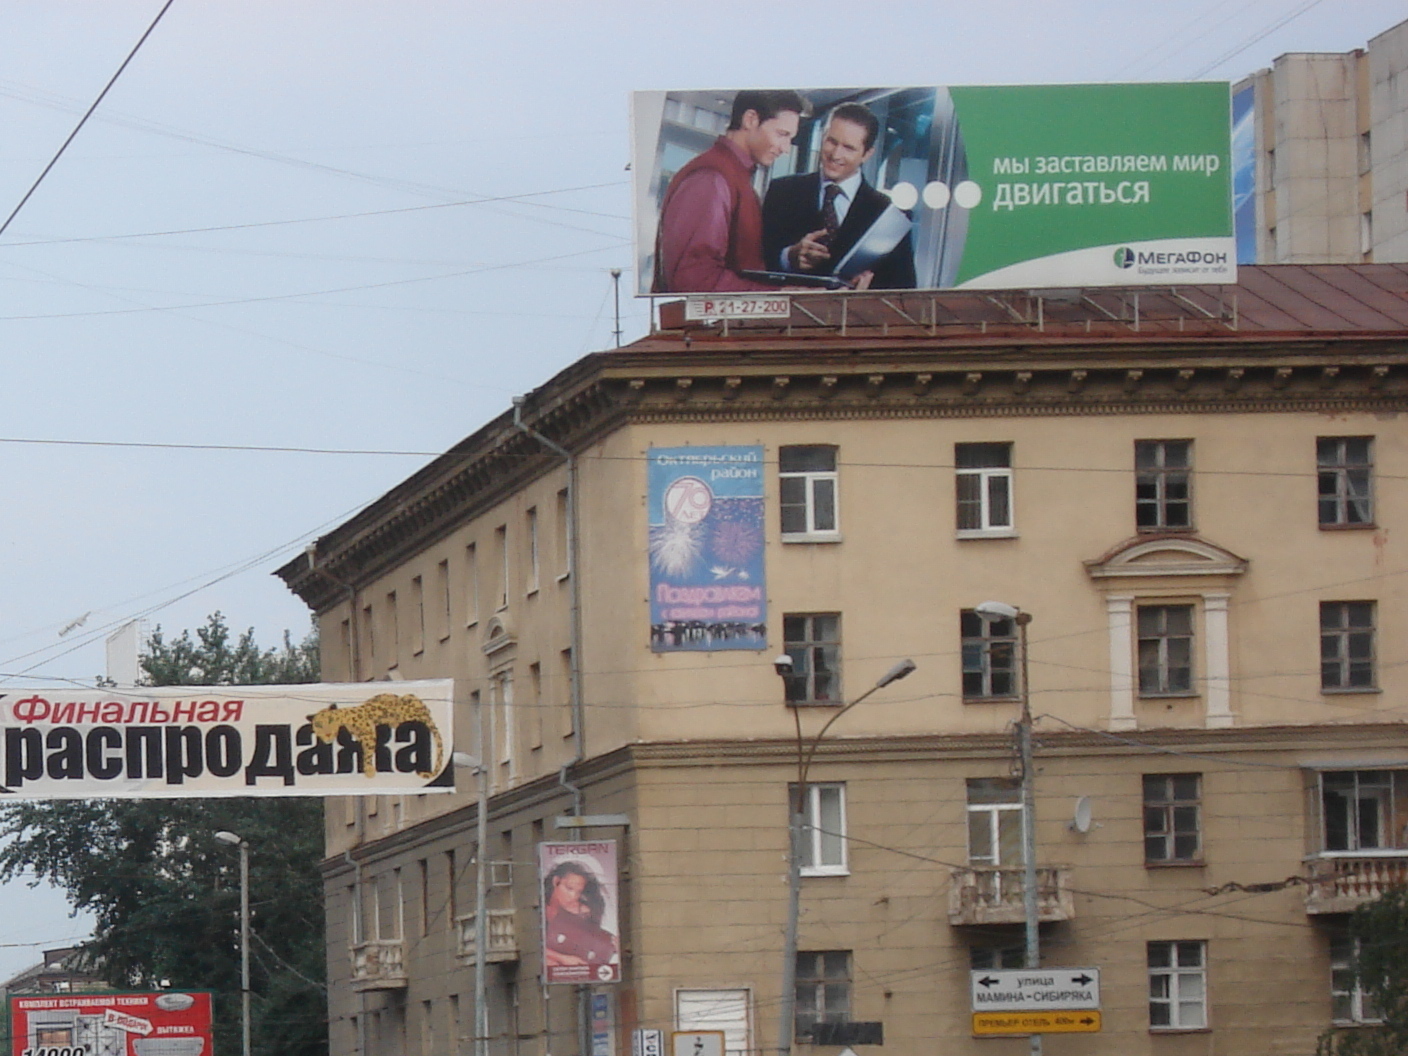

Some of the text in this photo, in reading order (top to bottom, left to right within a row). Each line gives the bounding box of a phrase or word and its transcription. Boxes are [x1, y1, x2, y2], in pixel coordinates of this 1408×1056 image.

[993, 153, 1220, 177] мы заставляем мир
[993, 181, 1150, 211] двигаться
[656, 453, 758, 467] Октябрьский
[711, 467, 758, 480] район
[13, 699, 244, 724] Финальная
[548, 844, 609, 855] TERGAN
[1016, 976, 1055, 989] улица
[979, 1019, 1020, 1028] ПРЕМЬЕР
[1022, 1018, 1050, 1027] ОТЕЛЬ
